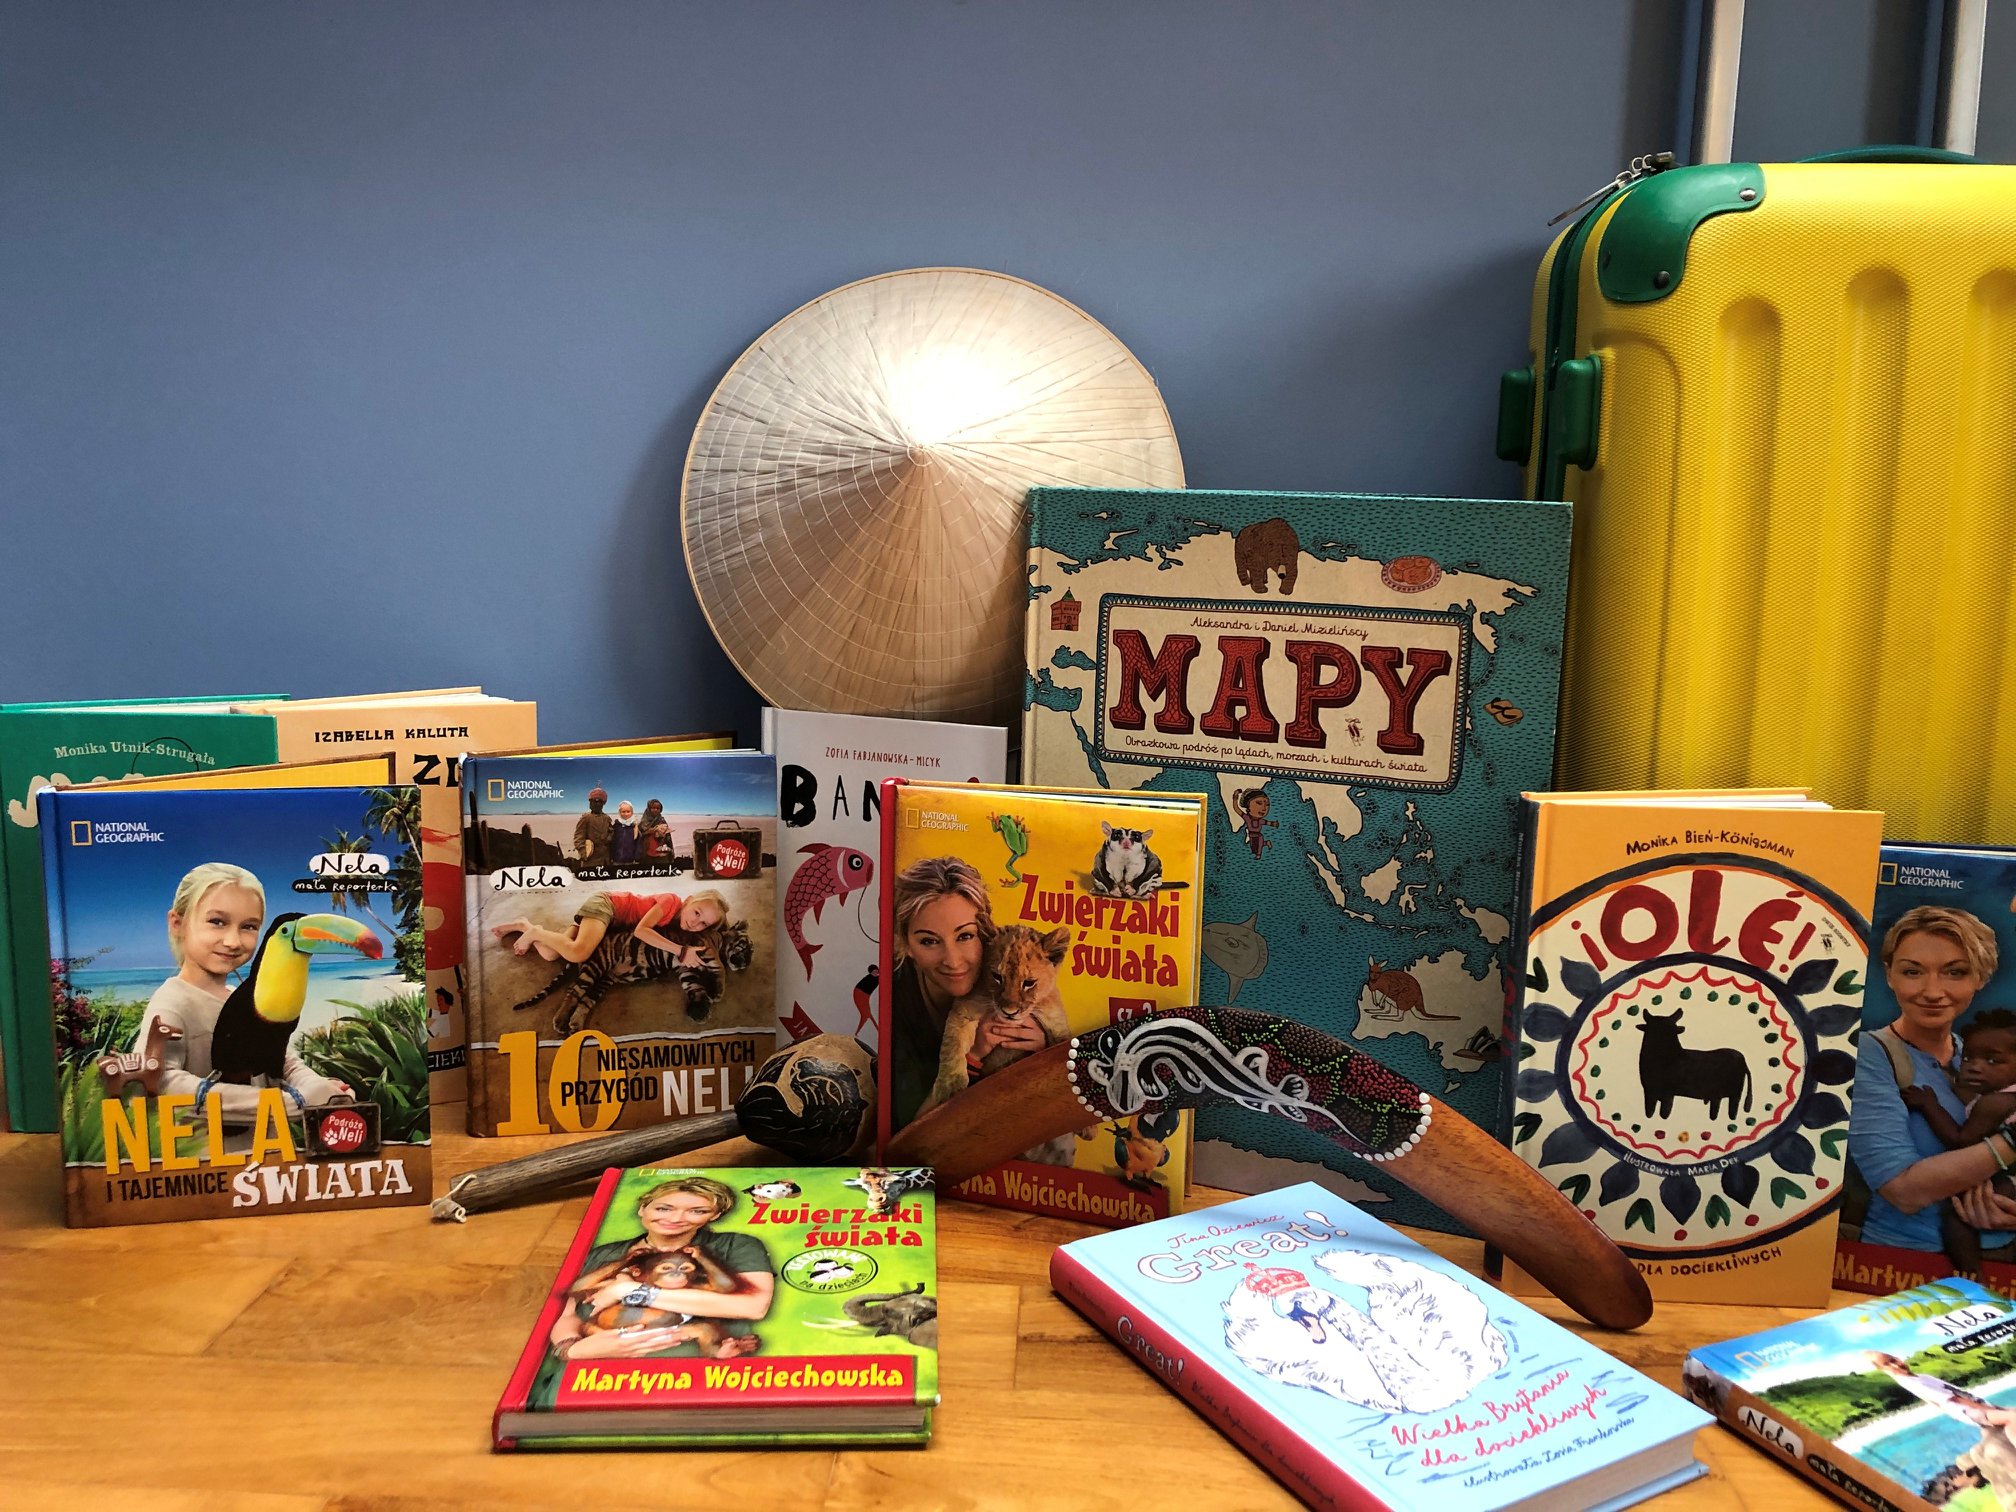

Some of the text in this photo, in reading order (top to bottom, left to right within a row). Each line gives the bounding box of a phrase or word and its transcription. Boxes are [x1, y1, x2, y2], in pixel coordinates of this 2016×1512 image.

[1190, 616, 1369, 642] Aleksandra i Daniel Mizielińscy
[1109, 629, 1452, 756] MAPY
[315, 726, 469, 743] IZABELLA KALUTA
[54, 741, 216, 765] Monika Utnik-Strugała
[825, 746, 849, 759] ZOFIA
[1125, 735, 1181, 752] Obrazkowa
[1183, 739, 1219, 755] podróż
[1220, 745, 1234, 758] po
[1276, 751, 1321, 764] morzach
[1322, 754, 1329, 765] i
[1331, 753, 1386, 770] kulturach
[1388, 758, 1428, 773] świata
[507, 780, 552, 790] NATIONAL
[507, 789, 564, 799] GEOGRAPHIC
[95, 822, 150, 833] NATIONAL
[921, 811, 959, 822] NATIONAL
[921, 820, 969, 832] GEOGRAPHIC
[95, 832, 165, 844] GEOGRAPHIC
[716, 842, 746, 859] Podróże
[314, 853, 384, 875] Nela
[723, 855, 747, 871] Neli
[1901, 866, 1951, 878] NATIONAL
[494, 866, 566, 891] Nela
[1899, 876, 1964, 889] GEOGRAPHIC
[1019, 873, 1180, 938] Zwierzaki
[1071, 931, 1179, 987] świata
[597, 1039, 755, 1072] NIESAMOWITYCH
[496, 1029, 627, 1136] 10
[560, 1072, 658, 1106] PRZYGÓD
[101, 1087, 297, 1175] NELA
[327, 1114, 364, 1130] Podróże
[338, 1126, 364, 1144] Neli
[106, 1171, 229, 1203] I TAJEMNICE
[232, 1159, 413, 1208] ŚWIATA
[1002, 1170, 1155, 1223] Wojciechowska
[747, 1202, 923, 1226] Zwierzaki
[804, 1226, 923, 1248] świata
[1137, 1210, 1349, 1284] Great!
[1167, 1232, 1209, 1249] Tina
[1637, 1261, 1664, 1276] DLA
[1833, 1251, 1938, 1290] Martyn
[1933, 1309, 2004, 1337] Nela
[1117, 1315, 1185, 1386] Great!
[571, 1363, 904, 1394] Martyna Wojciechowska
[1392, 1369, 1570, 1446] Wielka Brytania
[1421, 1384, 1607, 1467] dla dociekliwych
[1738, 1409, 1798, 1459] Nela
